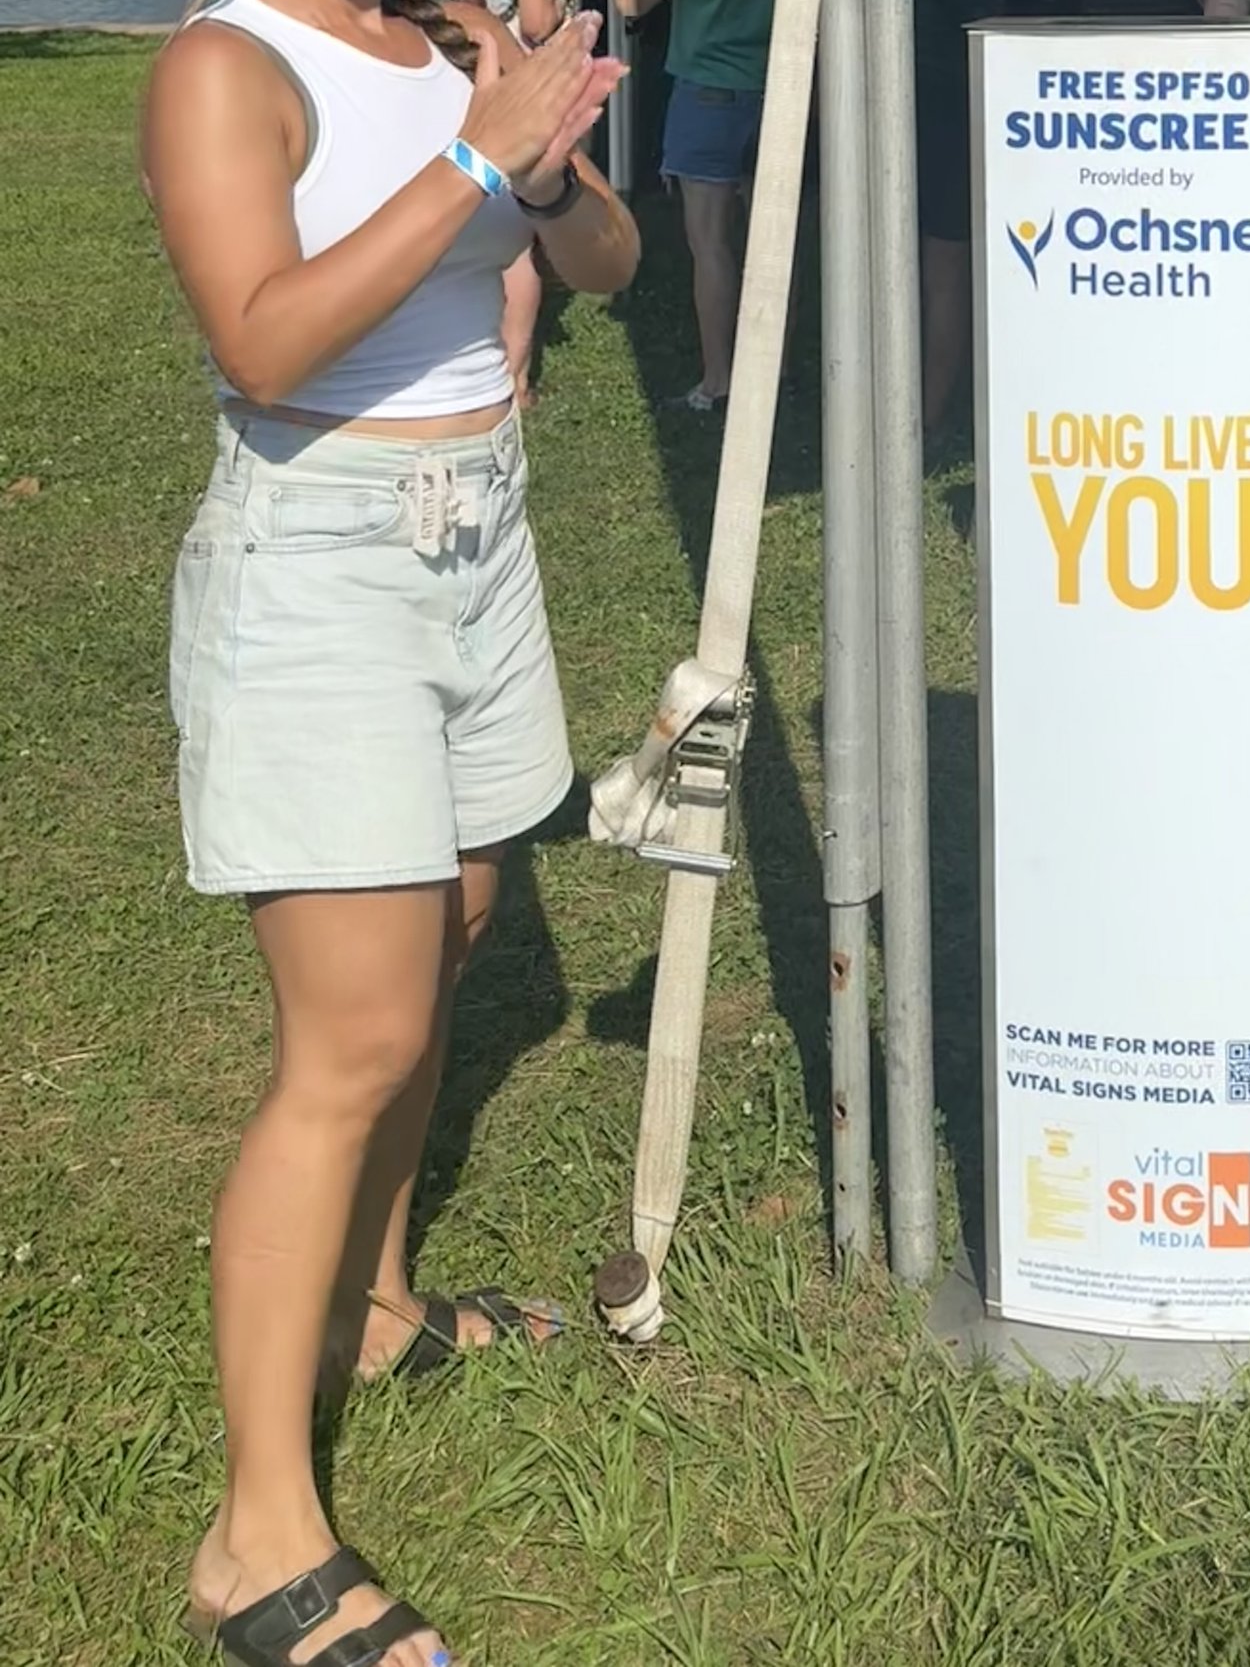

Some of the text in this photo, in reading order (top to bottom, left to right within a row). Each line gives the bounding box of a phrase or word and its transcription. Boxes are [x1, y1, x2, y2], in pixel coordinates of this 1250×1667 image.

[1038, 70, 1250, 101] FREE SPF50
[1079, 168, 1194, 191] Provided by
[1070, 262, 1211, 297] Health
[1027, 411, 1145, 470] LONG
[1006, 1023, 1216, 1057] SCAN ME FOR MORE
[1006, 1046, 1214, 1080] INFORMATION ABOUT
[1006, 1070, 1216, 1105] VITAL SIGNS MEDIA
[1134, 1147, 1203, 1177] vital
[1139, 1231, 1206, 1249] MEDIA
